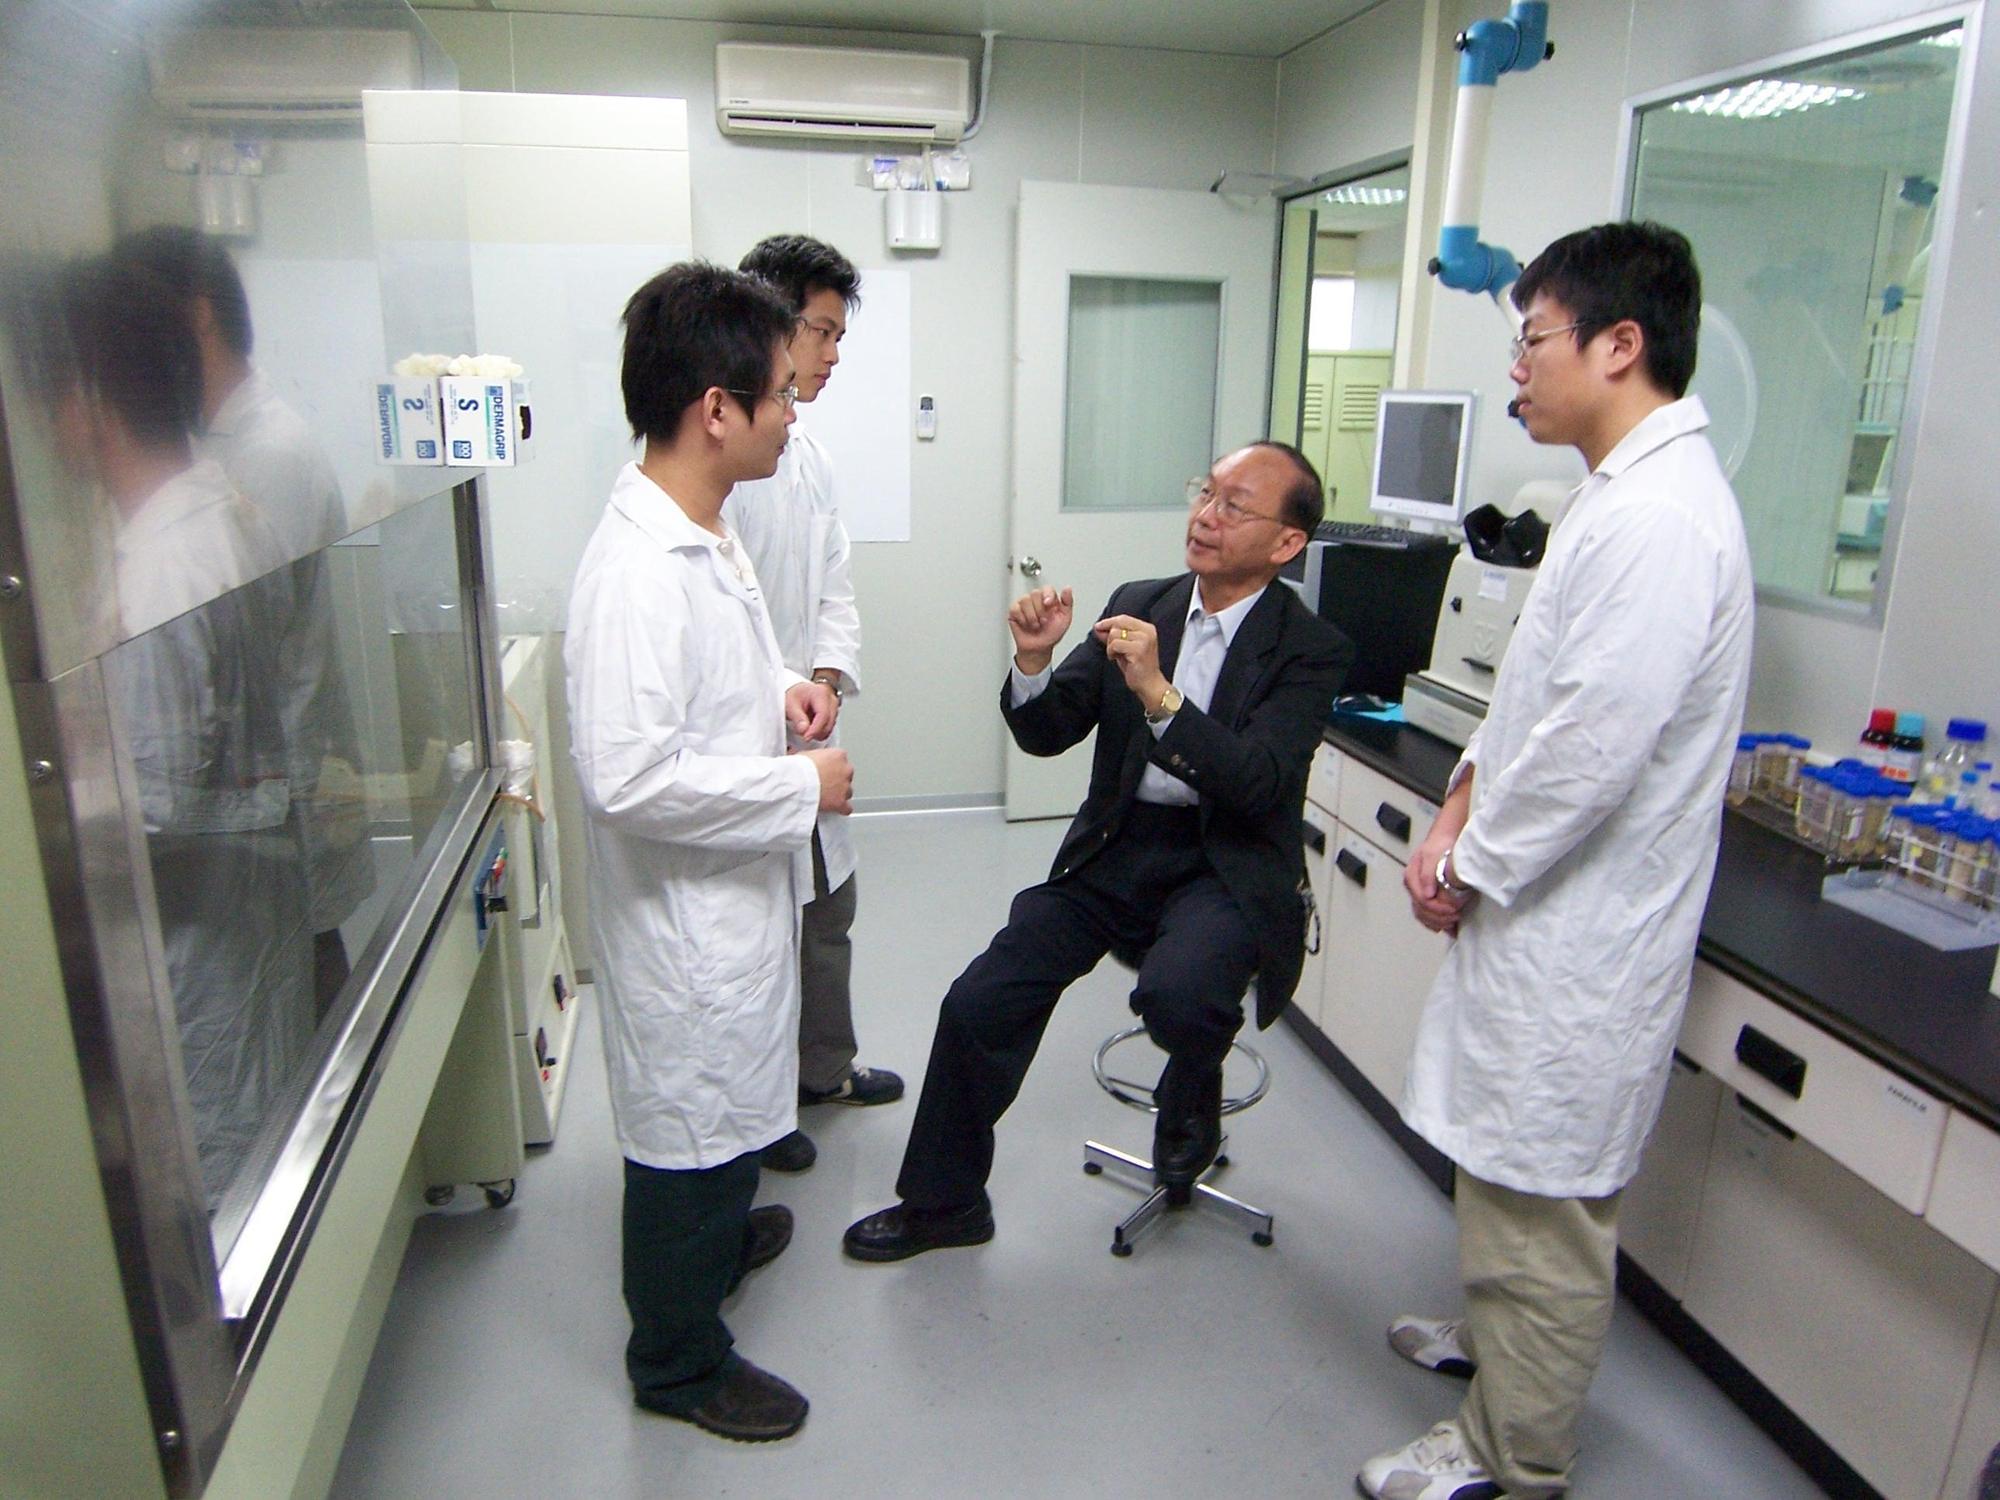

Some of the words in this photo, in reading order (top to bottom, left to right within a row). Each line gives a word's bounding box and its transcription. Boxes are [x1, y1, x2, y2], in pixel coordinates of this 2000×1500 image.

[458, 398, 479, 412] S
[492, 396, 506, 460] DERMAGRIP
[461, 443, 471, 457] 100
